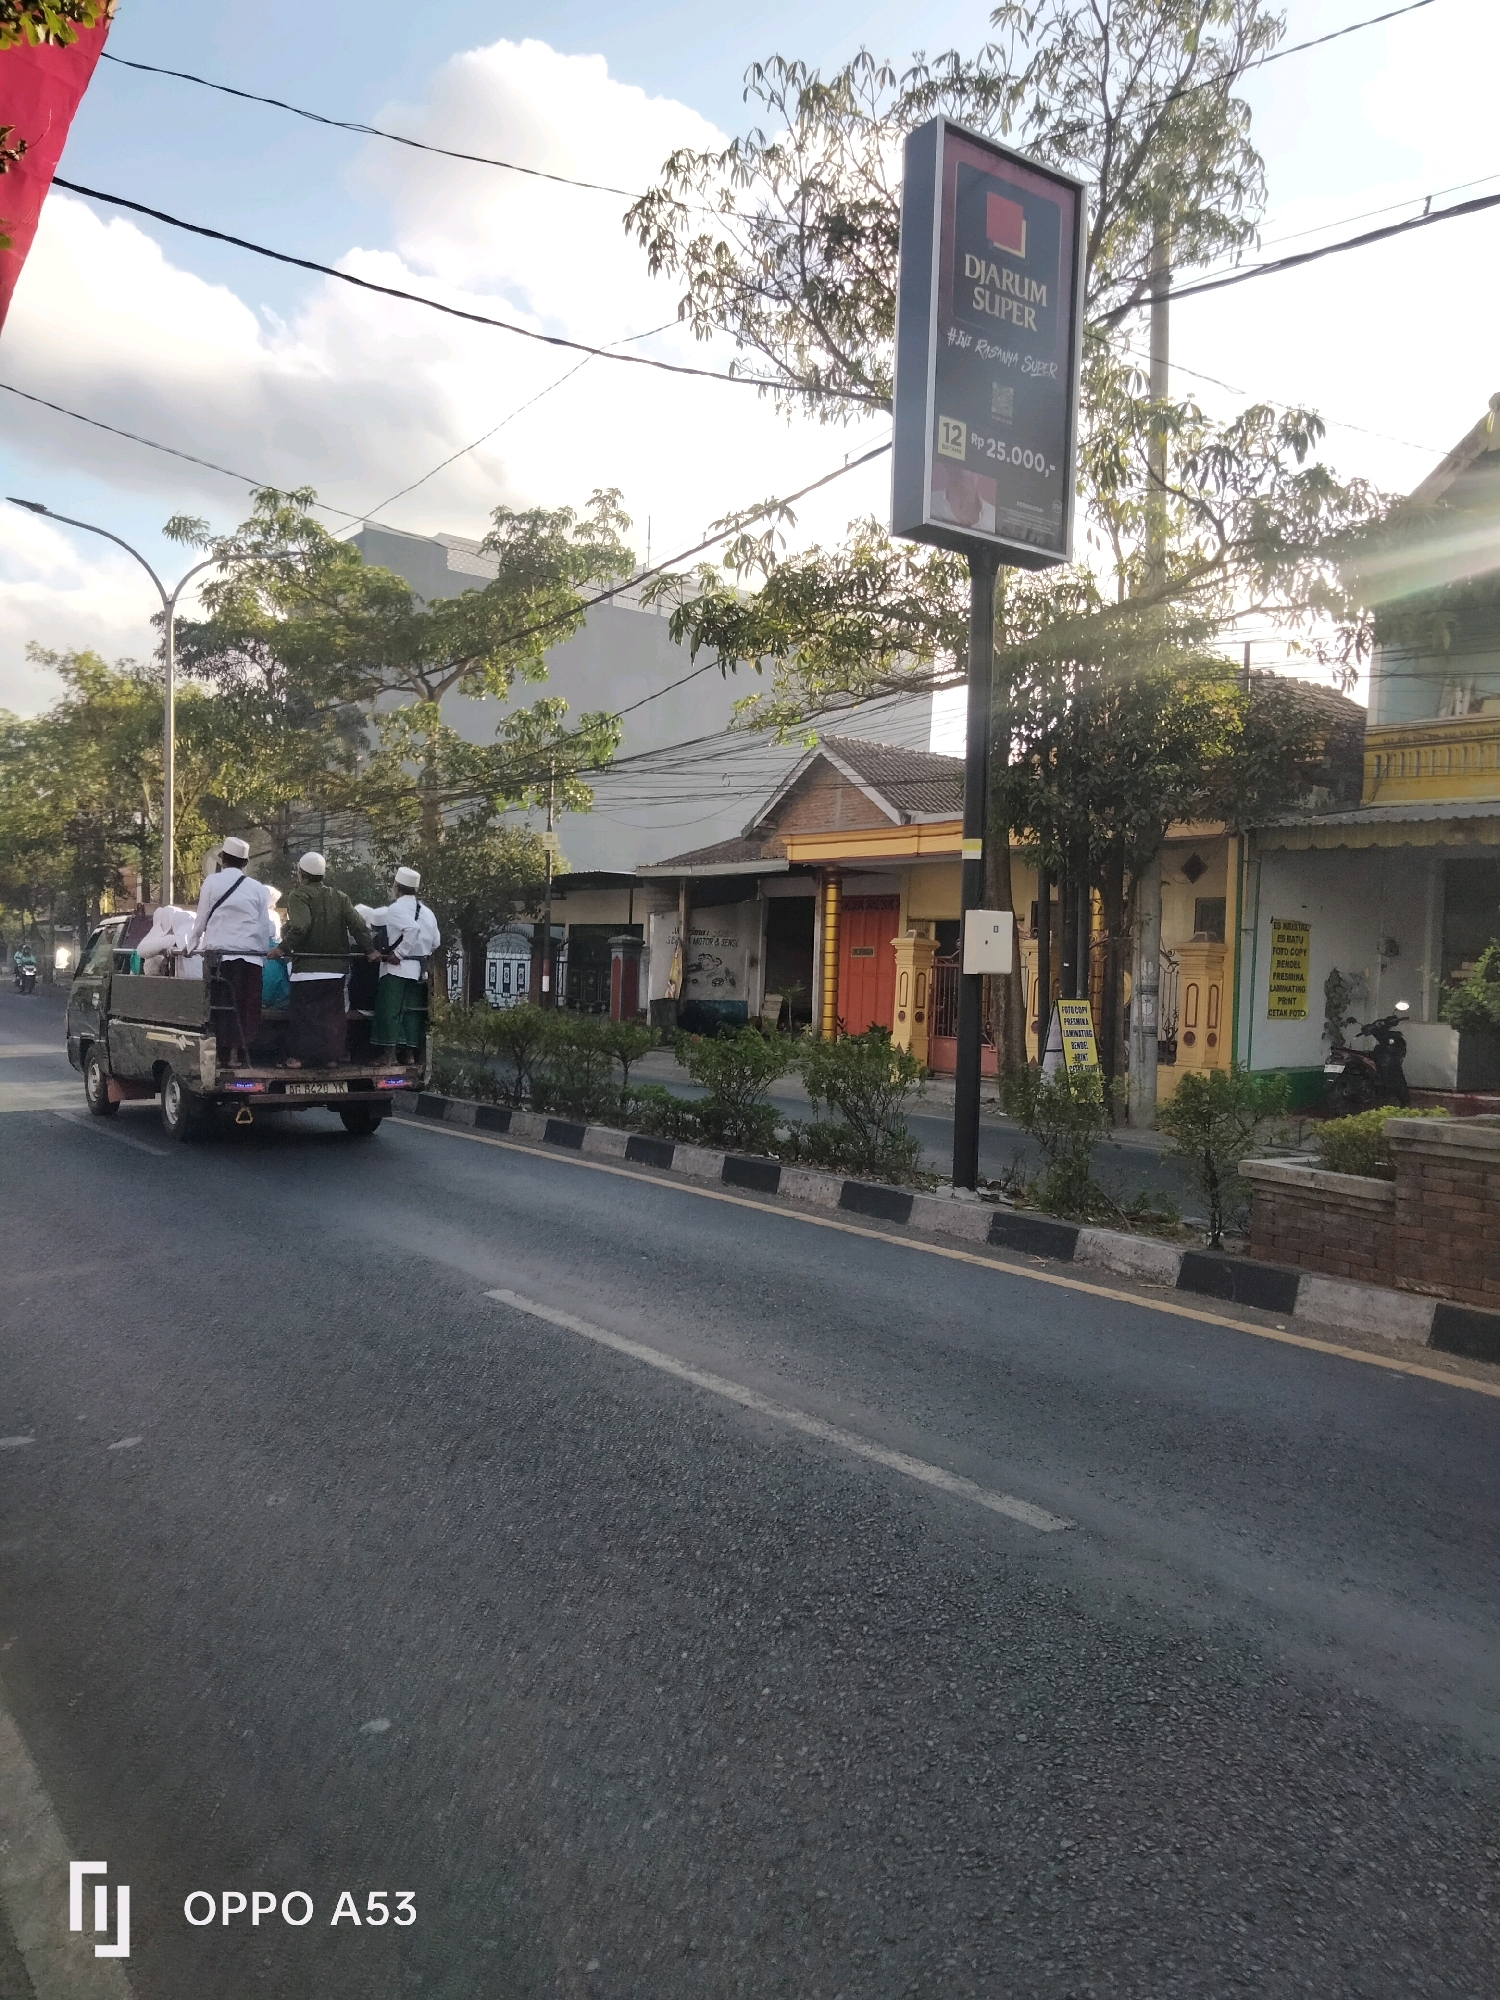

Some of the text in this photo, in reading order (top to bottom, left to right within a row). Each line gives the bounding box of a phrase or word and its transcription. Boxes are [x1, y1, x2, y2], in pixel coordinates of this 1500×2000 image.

[964, 253, 1047, 308] DJARUM
[972, 286, 1037, 332] SUPER
[943, 422, 962, 447] 12
[971, 432, 1056, 477] Rp 25.000,-
[1273, 922, 1281, 930] ES
[1277, 934, 1304, 945] ES BATU
[1272, 946, 1307, 957] FOTO COPY
[1276, 959, 1301, 969] BENDEL
[1277, 996, 1297, 1006] PRINT
[1289, 1009, 1307, 1018] FOTO
[1063, 1029, 1093, 1038] LAMINATING
